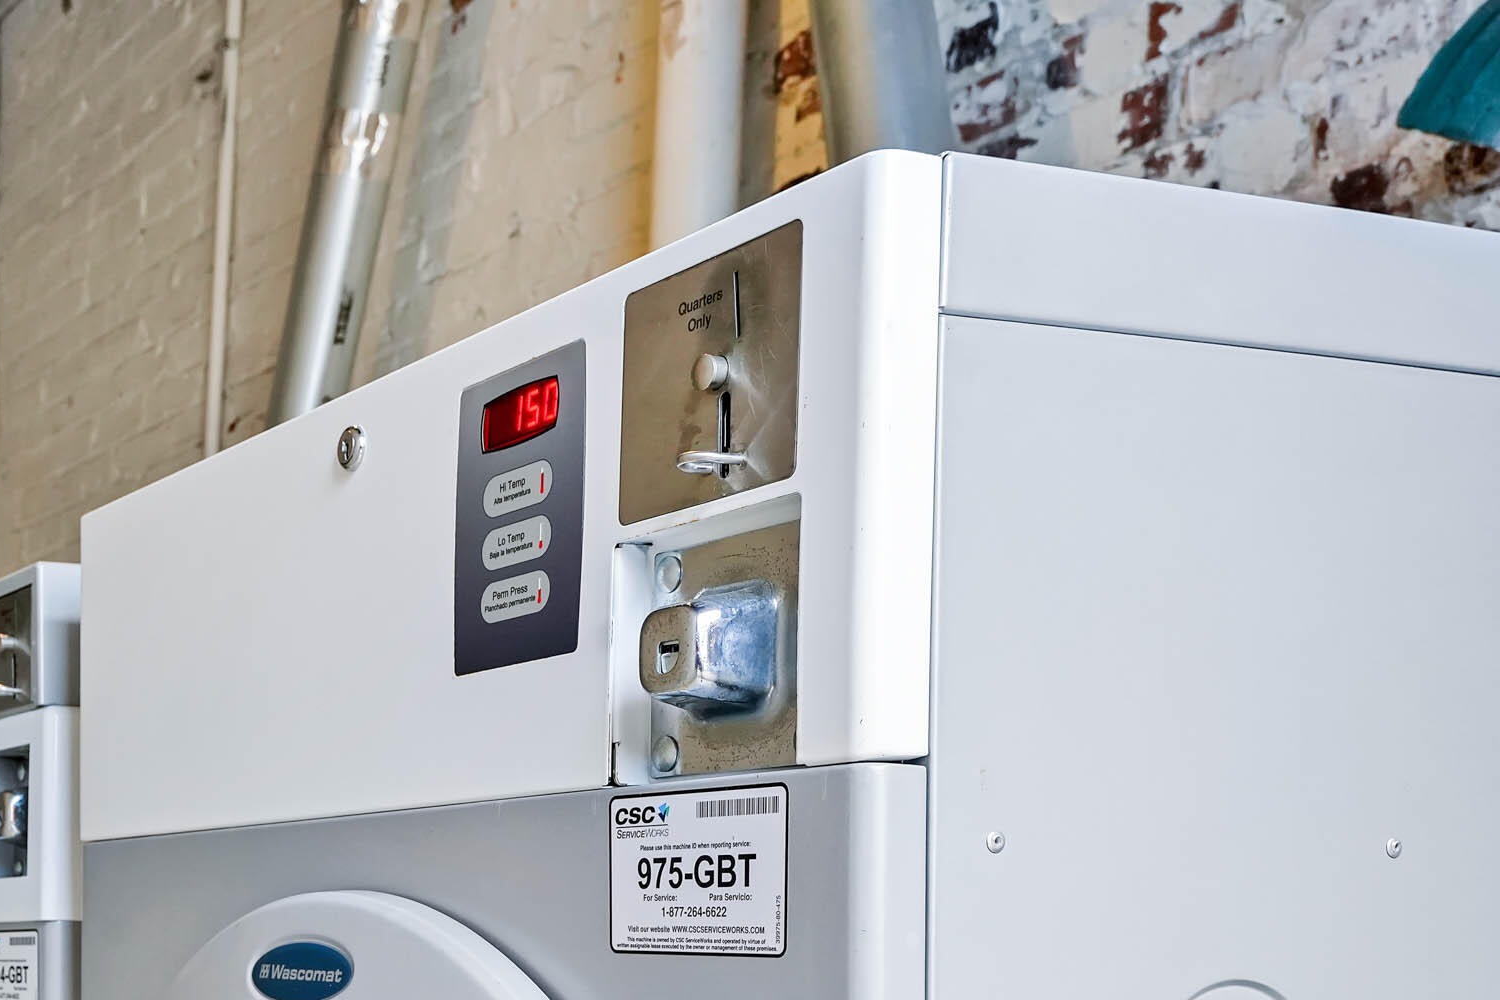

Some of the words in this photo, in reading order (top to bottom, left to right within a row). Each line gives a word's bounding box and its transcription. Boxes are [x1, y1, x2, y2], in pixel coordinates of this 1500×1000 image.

[678, 288, 723, 316] Quarters
[687, 312, 712, 332] Only
[517, 381, 558, 431] 150
[499, 482, 506, 493] Hi
[508, 478, 526, 489] Temp
[498, 537, 505, 546] Lo
[507, 532, 525, 543] Temp
[493, 590, 508, 601] Perm
[510, 585, 528, 596] Press
[615, 805, 656, 826] CSC
[637, 853, 757, 889] 975-GBT
[654, 894, 678, 902] Service:
[709, 893, 723, 901] Para
[724, 893, 753, 901] Servicio:
[662, 906, 727, 918] 1-877-264-6622
[627, 925, 639, 933] Visit
[672, 926, 765, 934] WWW.CSCSERVICEWORKS.COM
[271, 964, 342, 983] Wascomat
